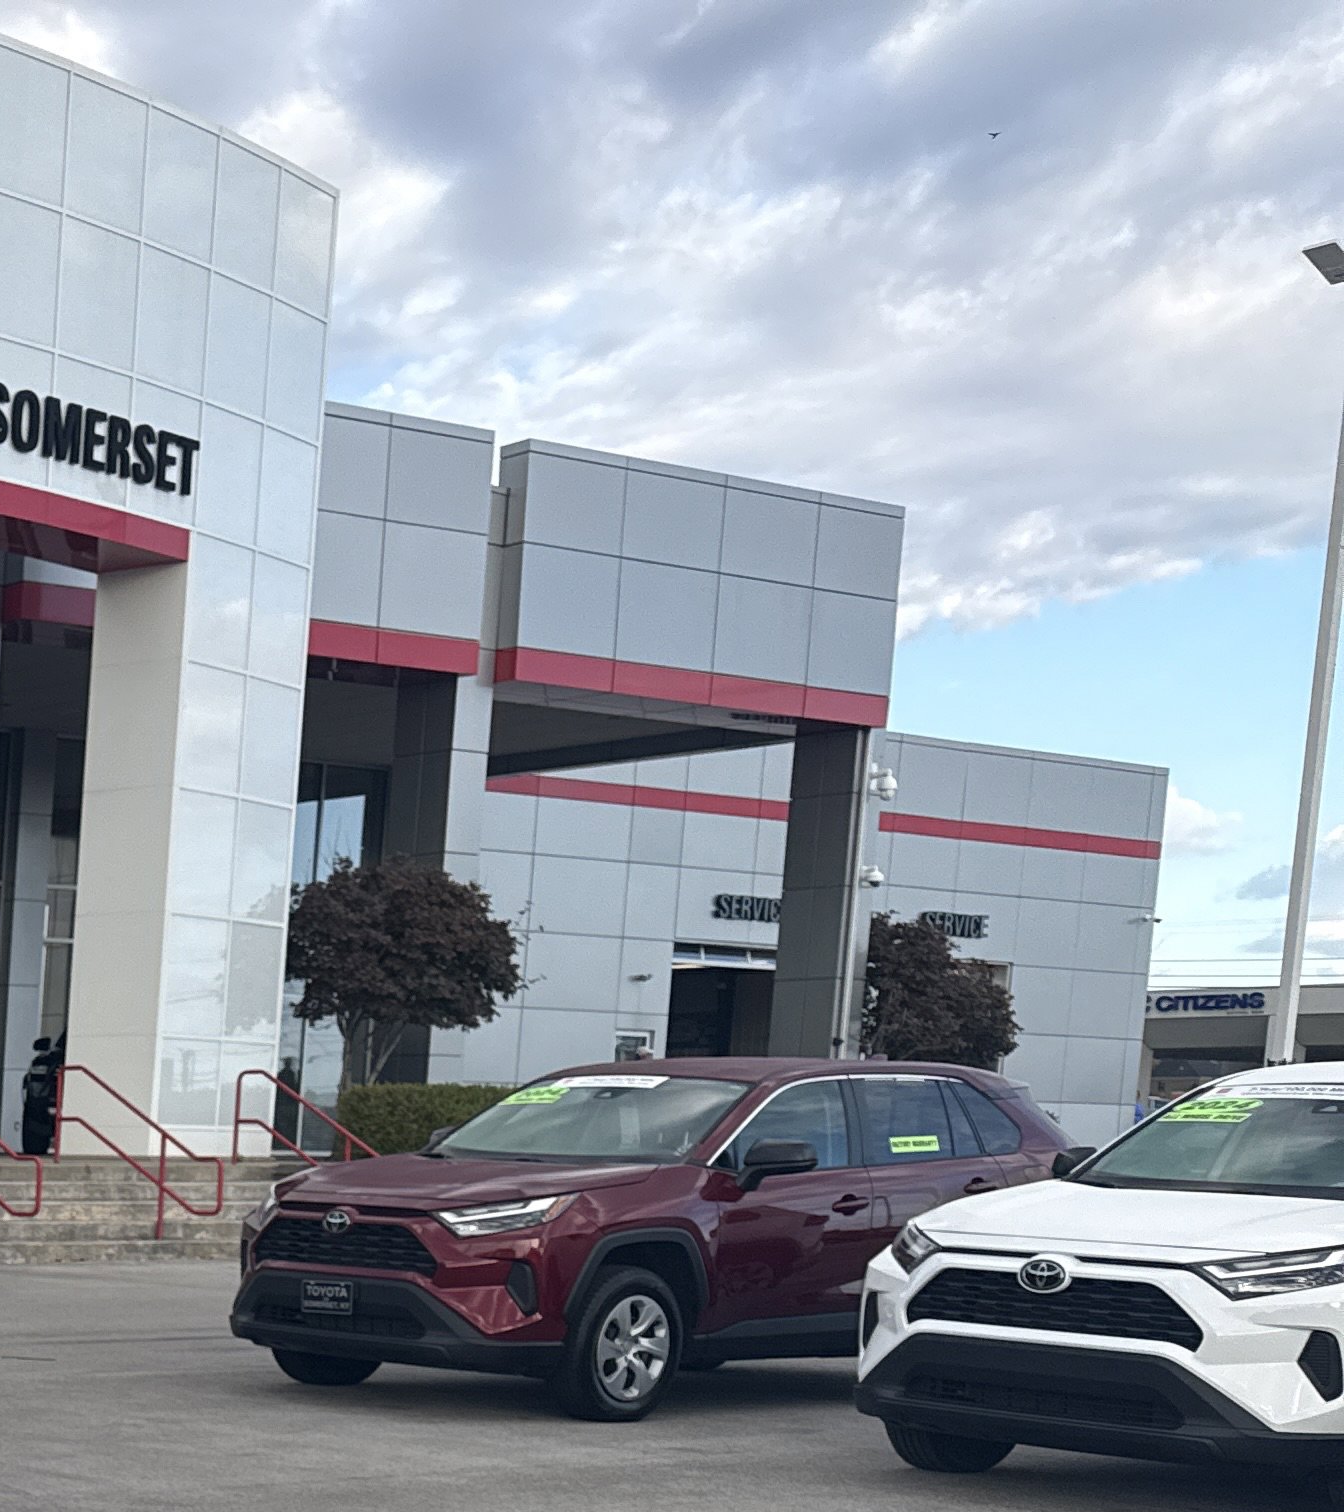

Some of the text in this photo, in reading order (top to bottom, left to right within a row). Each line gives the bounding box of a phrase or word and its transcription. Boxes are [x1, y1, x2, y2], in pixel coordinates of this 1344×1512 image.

[713, 894, 780, 923] SERVIC
[1155, 992, 1265, 1011] CITIZENS
[306, 1285, 348, 1298] TOYOTA
